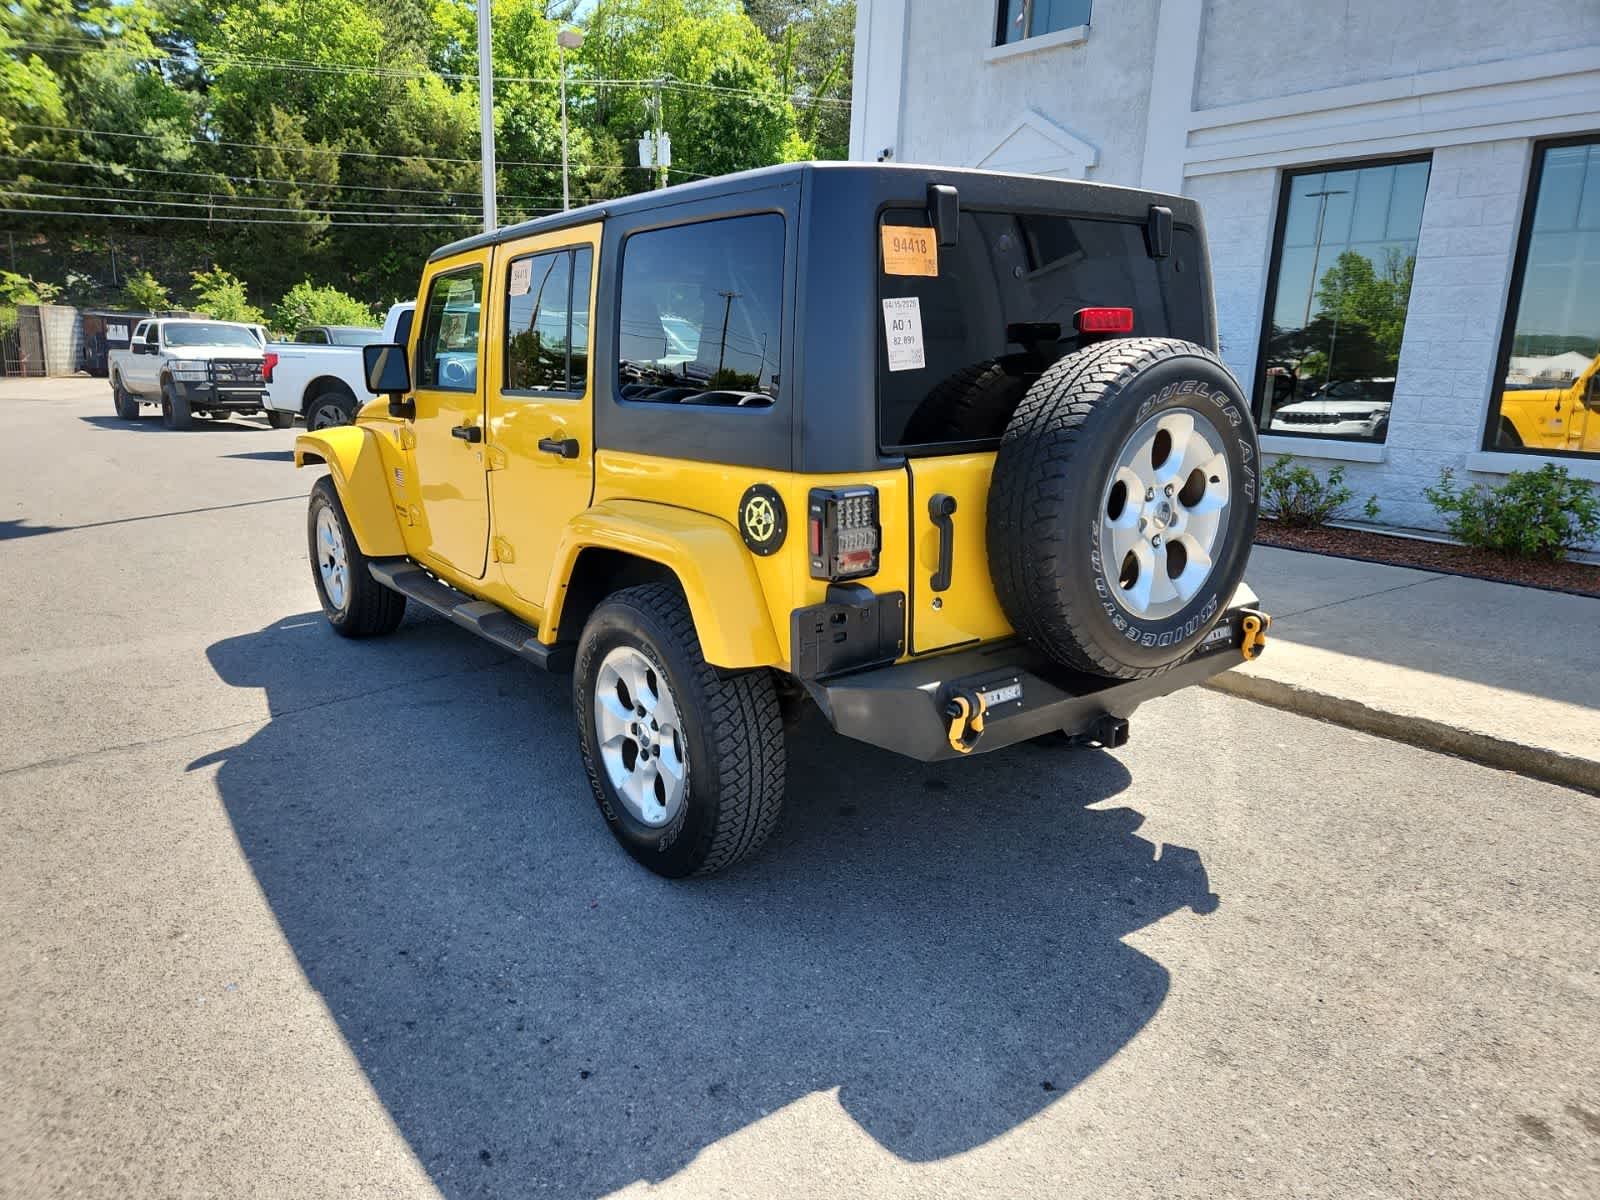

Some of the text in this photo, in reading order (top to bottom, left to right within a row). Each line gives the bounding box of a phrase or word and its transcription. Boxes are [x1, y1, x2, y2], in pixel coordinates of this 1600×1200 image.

[893, 237, 927, 254] 94418
[1136, 379, 1256, 506] DUELER A/T
[1090, 520, 1219, 648] BRIDGESTONE
